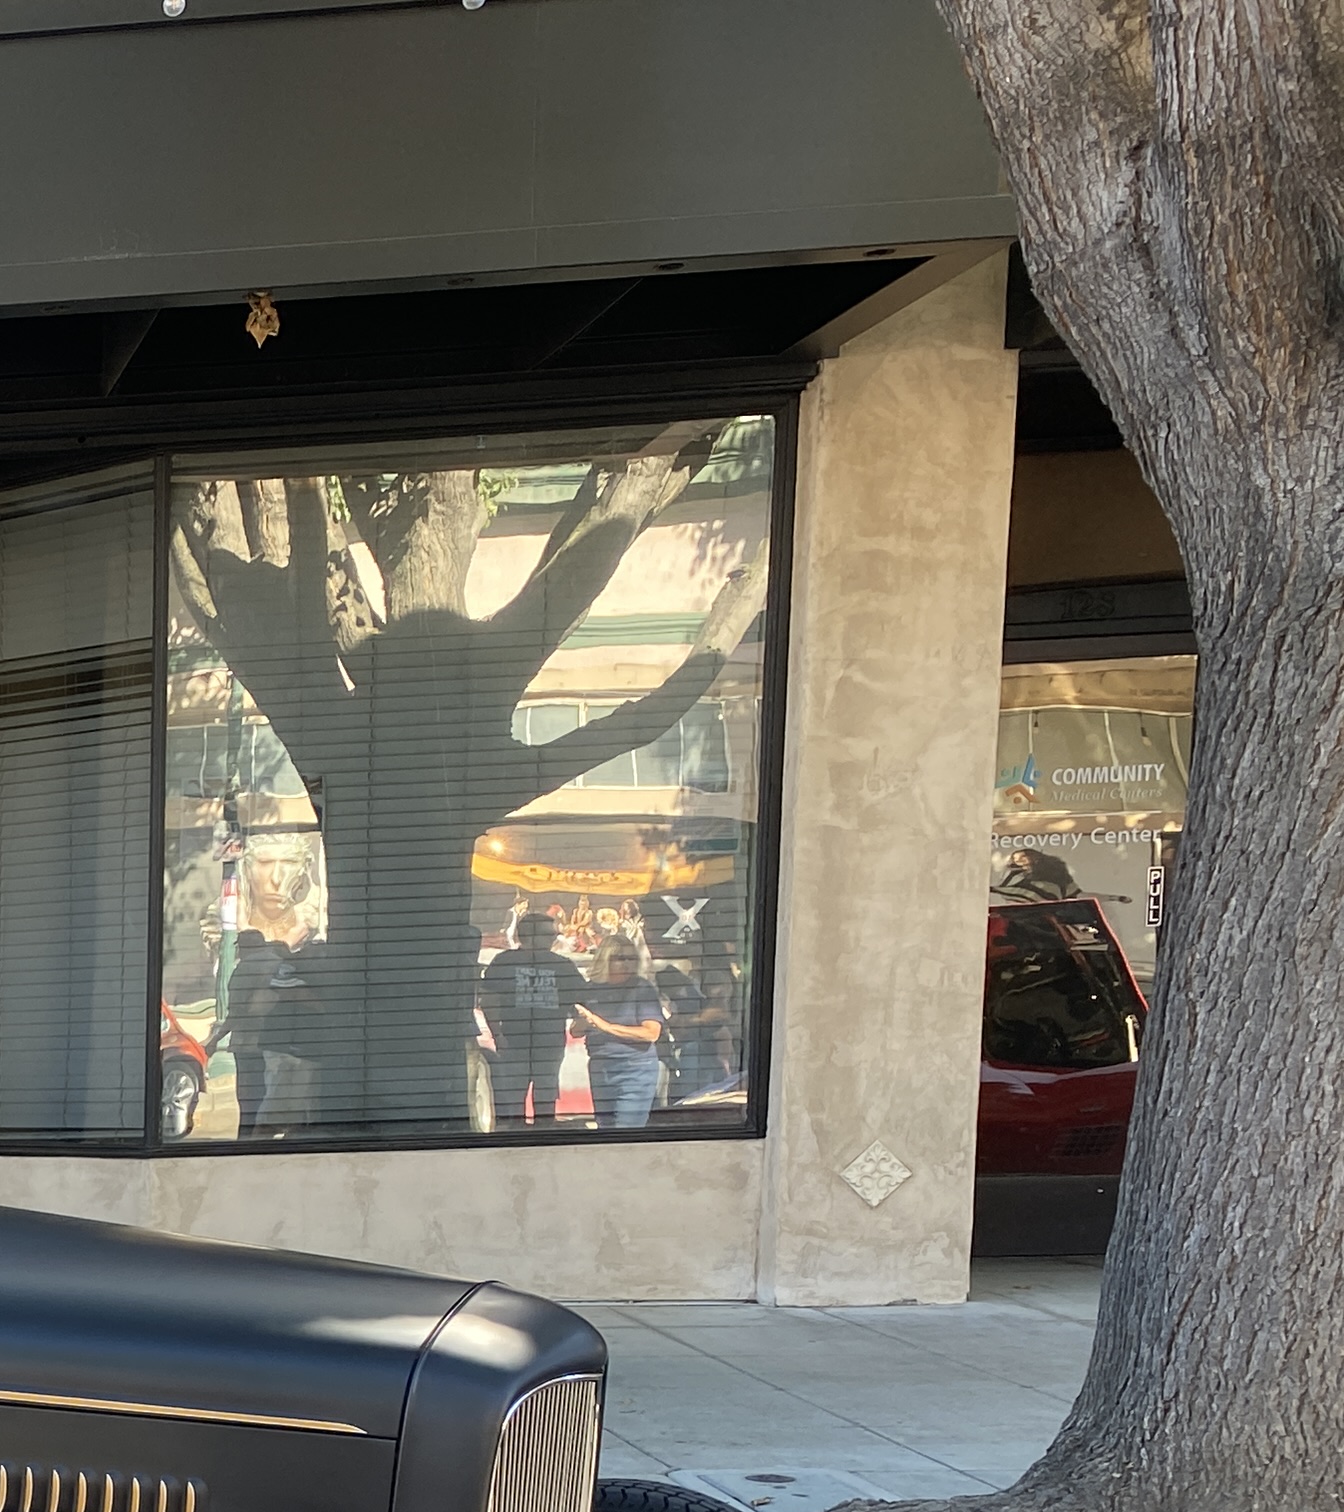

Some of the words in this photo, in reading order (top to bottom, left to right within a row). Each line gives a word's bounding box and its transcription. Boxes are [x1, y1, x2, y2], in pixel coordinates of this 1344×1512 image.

[1051, 763, 1165, 786] COMMUNITY
[1051, 787, 1106, 802] Medical
[1109, 786, 1163, 800] Centers
[989, 832, 1083, 850] Recovery
[1090, 826, 1163, 845] Center
[1149, 870, 1162, 922] PULL
